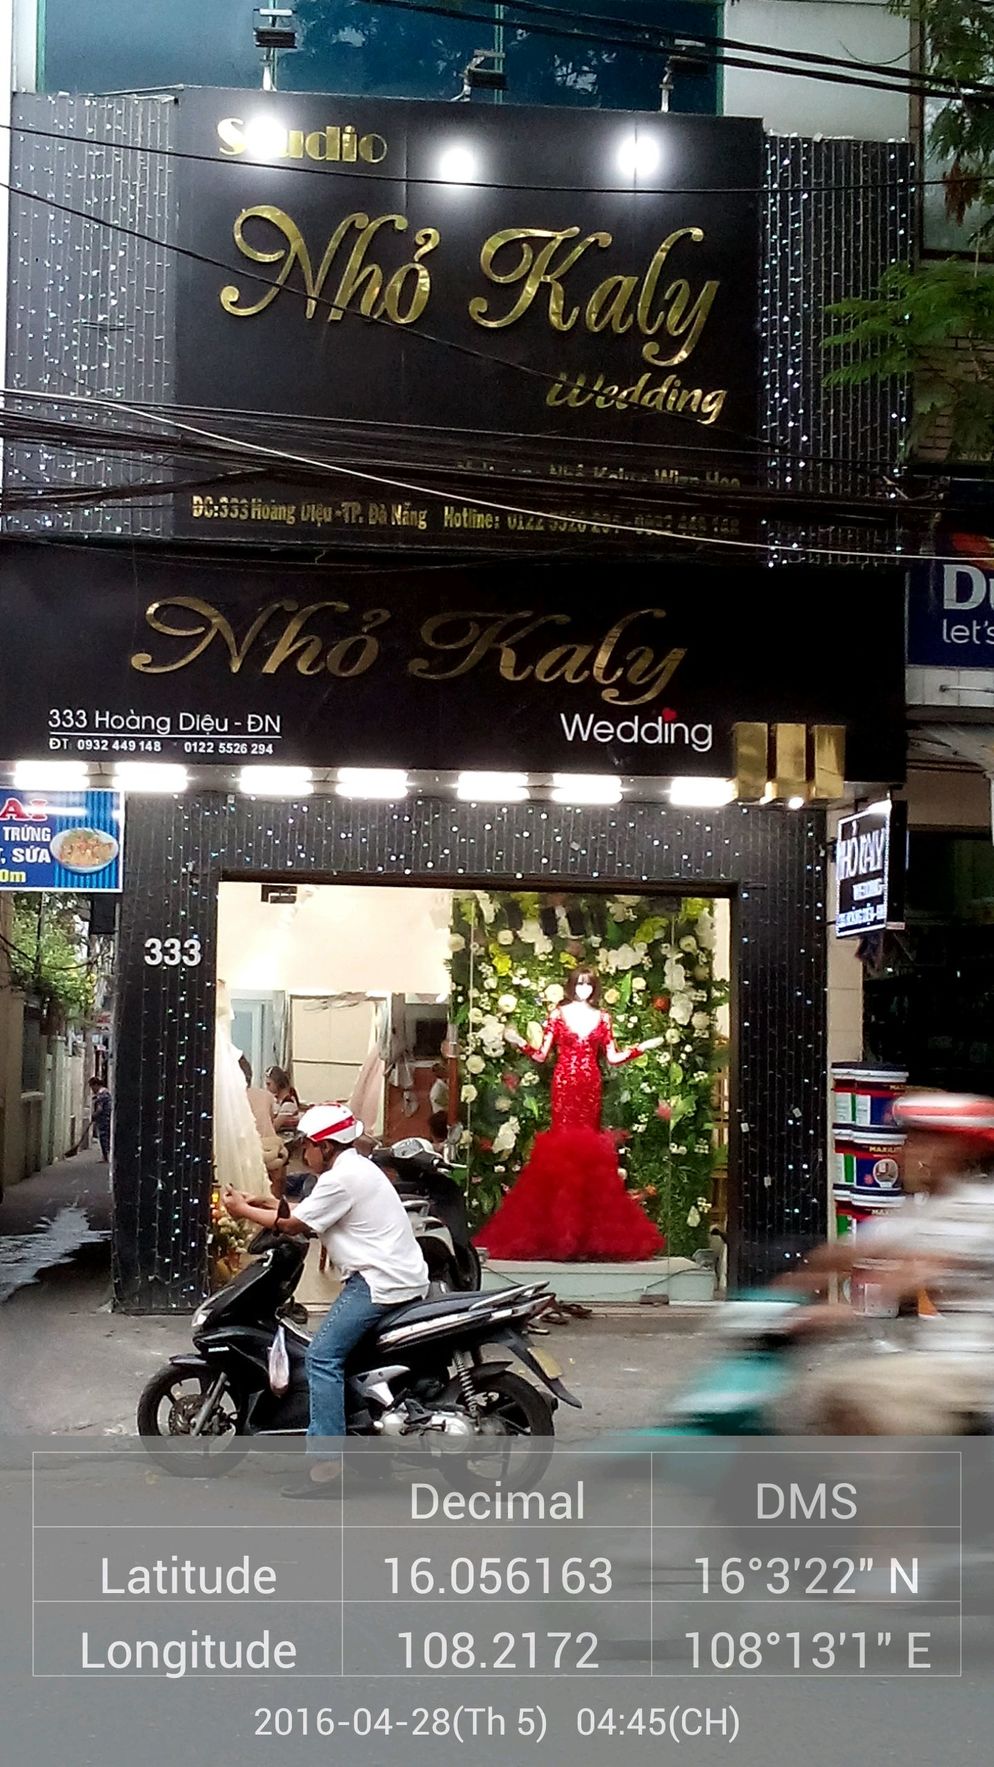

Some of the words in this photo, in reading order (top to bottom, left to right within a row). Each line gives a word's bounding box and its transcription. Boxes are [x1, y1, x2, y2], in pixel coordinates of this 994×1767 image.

[217, 117, 388, 163] Sudio
[218, 203, 441, 325] Nhỏ
[468, 225, 721, 367] Kaly
[545, 370, 728, 426] Wedding
[443, 505, 500, 531] Hotline:
[943, 564, 994, 611] D
[130, 596, 392, 677] Nhỏ
[407, 608, 689, 706] Kaly
[48, 709, 88, 728] 333
[95, 709, 171, 735] Hoàng
[179, 712, 229, 736] Diệu
[247, 714, 281, 733] ĐN
[560, 709, 713, 752] Wedding
[49, 738, 70, 750] ĐT
[77, 739, 109, 751] 0932
[112, 739, 136, 751] 449
[139, 740, 162, 752] 148
[184, 741, 215, 753] 0122
[218, 742, 248, 754] 5526
[250, 743, 274, 755] 294
[12, 845, 52, 863] SỨA
[144, 938, 201, 967] 333
